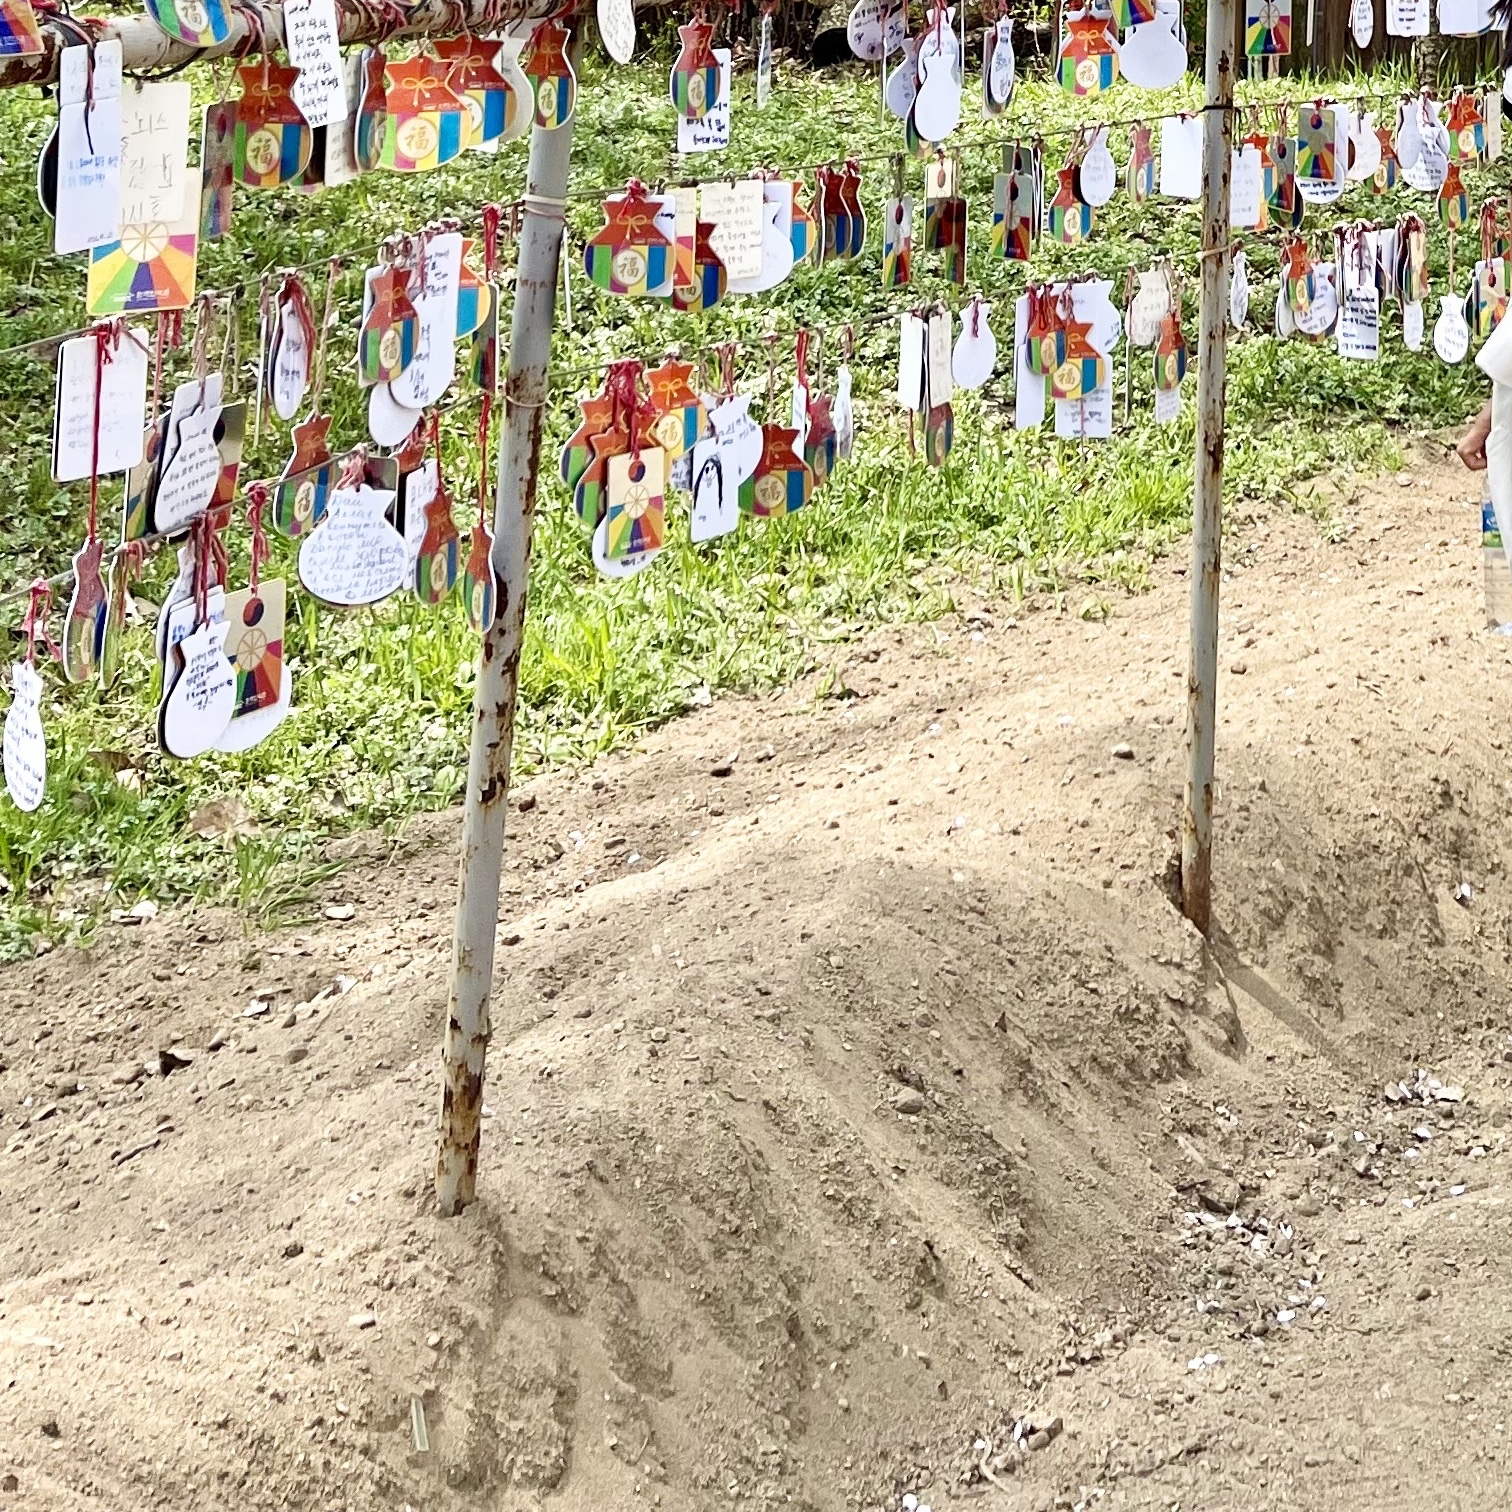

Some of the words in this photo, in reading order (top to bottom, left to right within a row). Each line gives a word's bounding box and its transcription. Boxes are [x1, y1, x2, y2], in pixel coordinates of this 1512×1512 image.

[1080, 60, 1096, 82] 福
[404, 126, 430, 150] 福
[618, 257, 640, 278] 福
